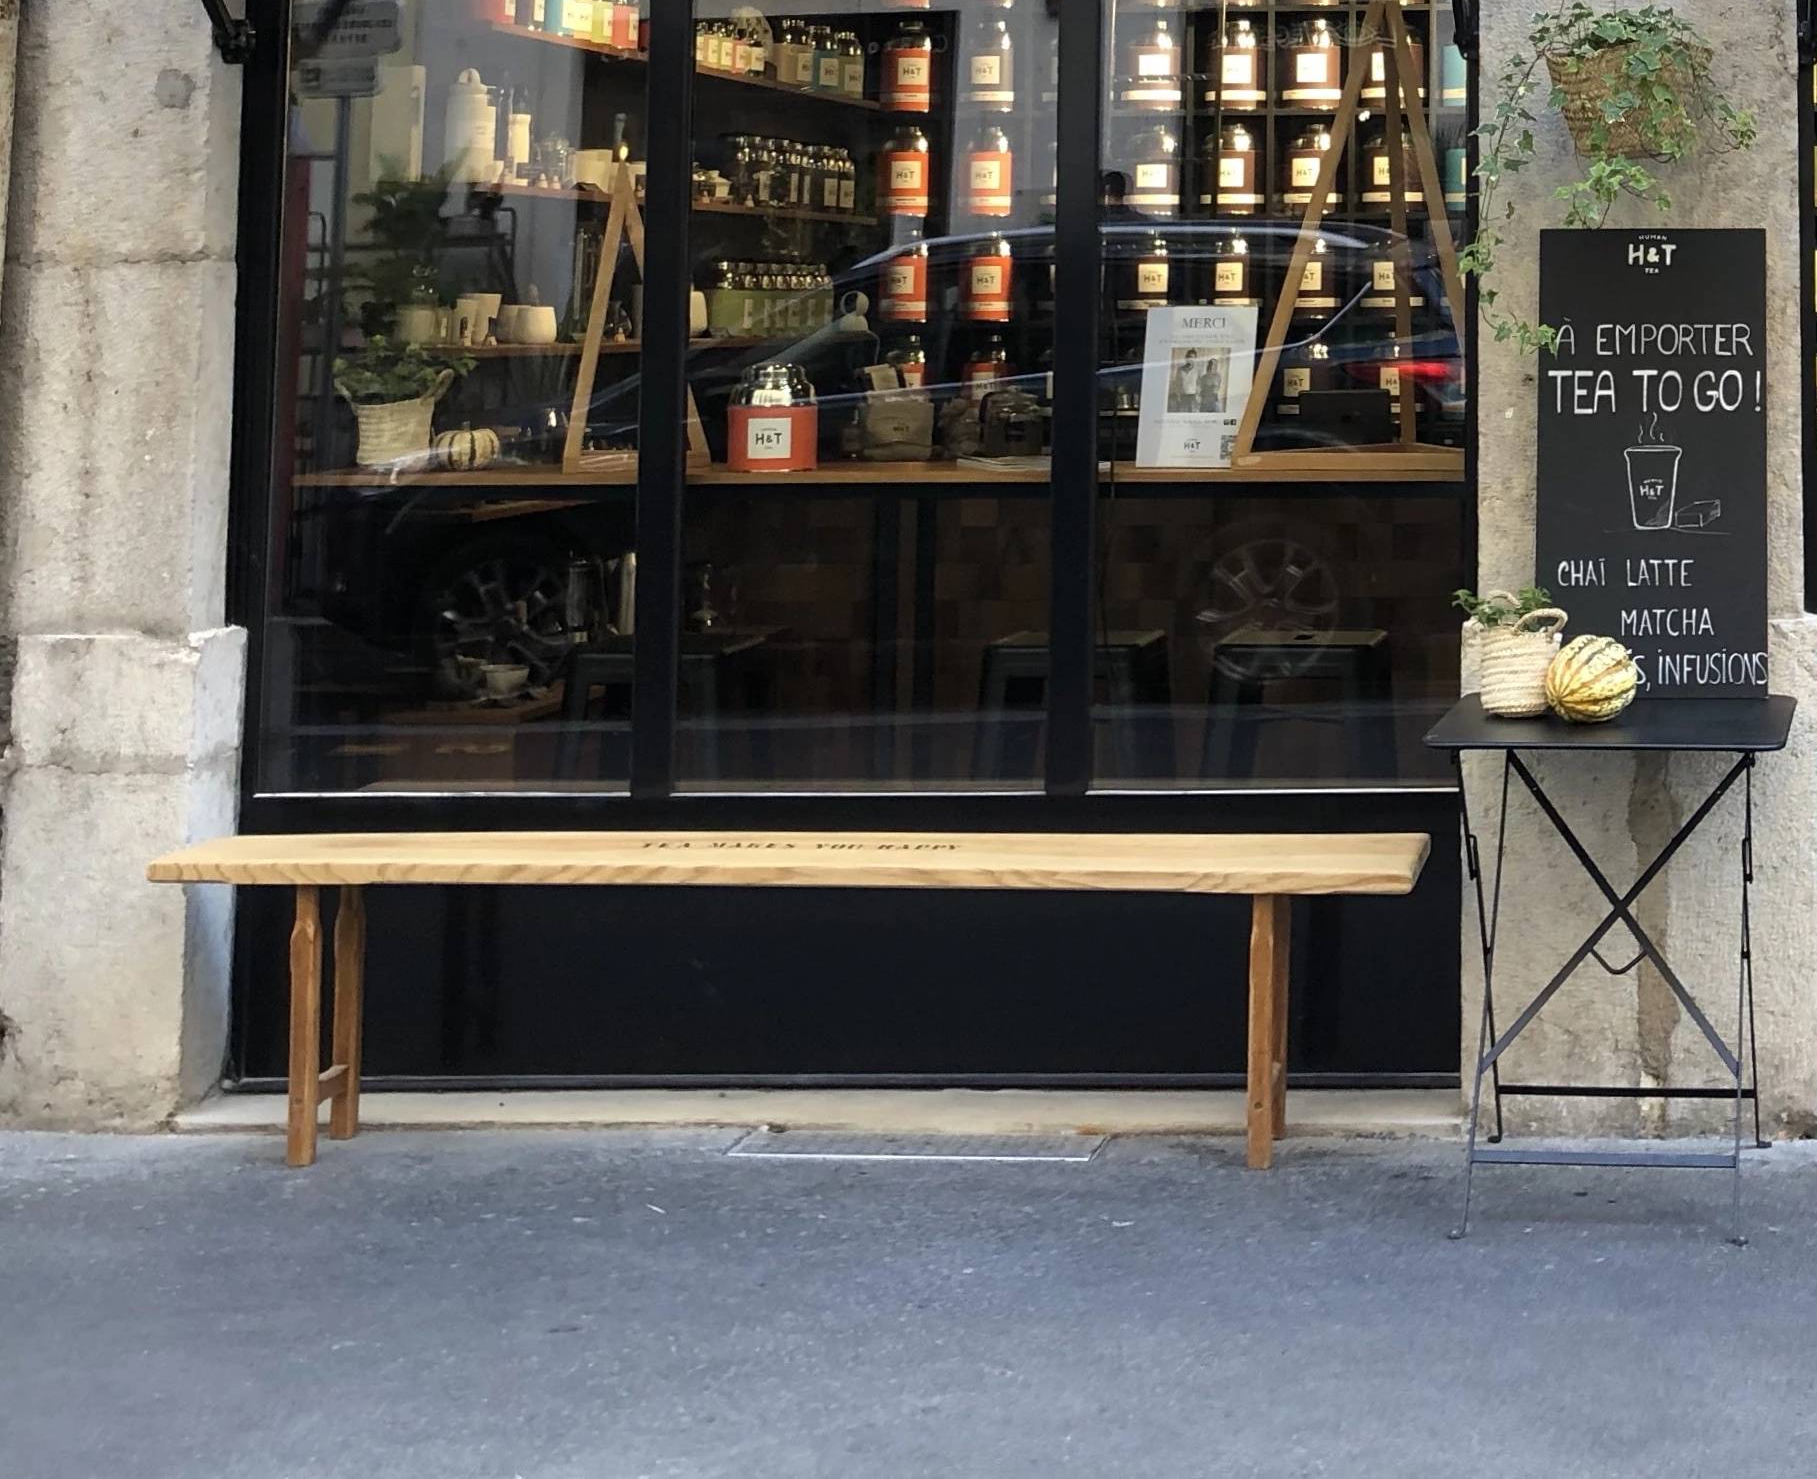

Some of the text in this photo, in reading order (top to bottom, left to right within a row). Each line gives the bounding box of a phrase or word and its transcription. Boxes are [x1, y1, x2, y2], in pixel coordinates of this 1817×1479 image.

[903, 67, 922, 76] H&T
[896, 171, 915, 179] H&T
[1628, 243, 1677, 266] H&T
[1143, 274, 1163, 282] H&T
[1218, 273, 1236, 281] H&T
[1182, 317, 1226, 329] MERCI
[1596, 323, 1753, 356] EMPORTER
[1548, 370, 1616, 414] TEA
[1632, 370, 1683, 412] TO
[755, 433, 783, 445] H&T
[1639, 484, 1664, 496] H&T
[1626, 559, 1694, 587] LATTE
[1621, 608, 1715, 636] MATCHA
